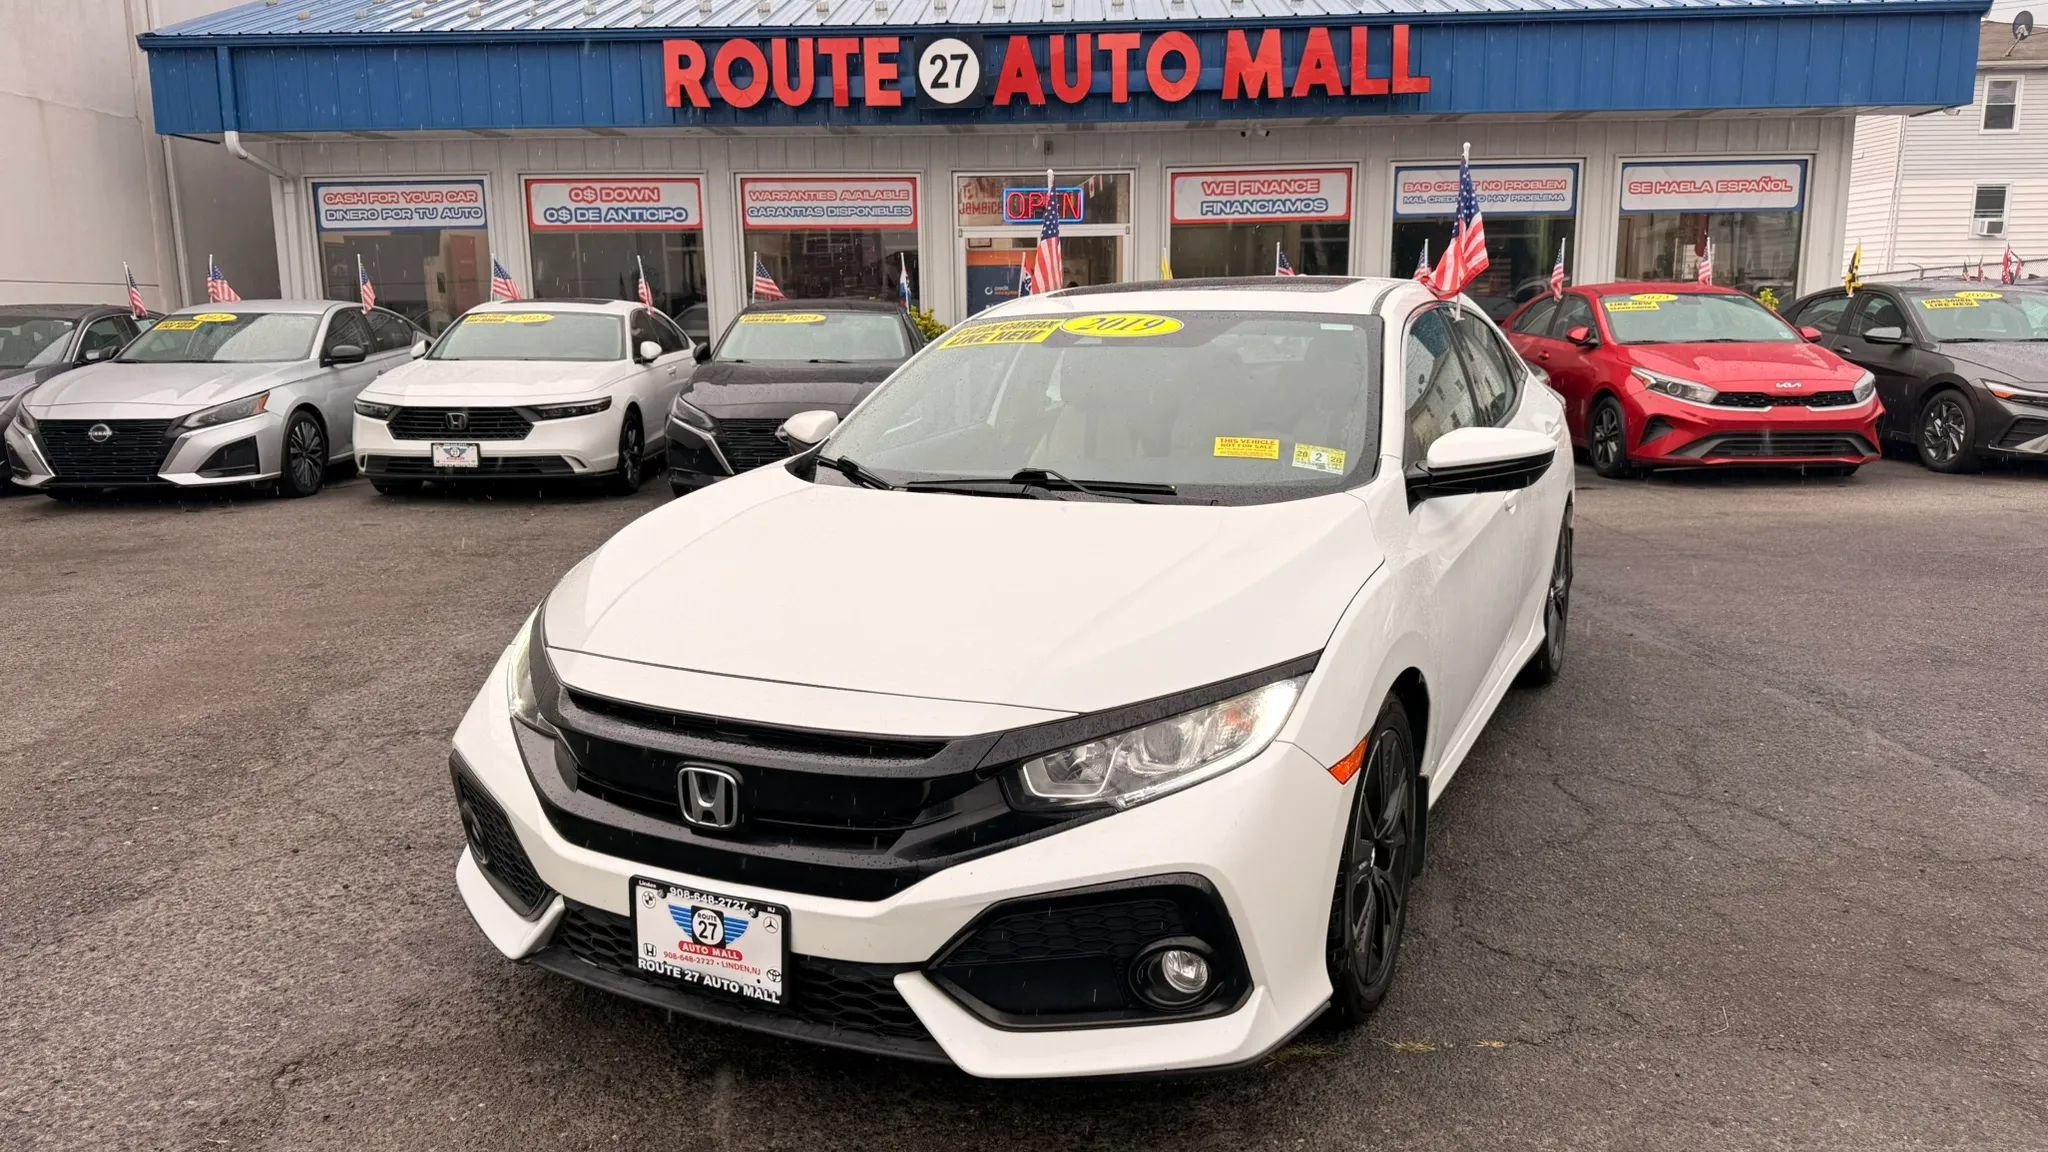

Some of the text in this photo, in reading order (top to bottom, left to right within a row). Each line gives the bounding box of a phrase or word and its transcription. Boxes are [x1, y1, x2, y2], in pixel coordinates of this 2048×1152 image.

[663, 24, 1431, 109] ROUTE 27 AUTO MALL
[1201, 179, 1320, 196] WE FINANCE
[1403, 179, 1567, 193] BAD CRET NO PROBLEM
[1629, 176, 1793, 194] SE HABLA ESPAÑOL
[324, 190, 478, 205] CASH FOR YOUR CAR
[600, 186, 660, 203] DOWN
[749, 189, 910, 202] WARRANTIES AVAILABLE
[1403, 195, 1426, 205] MAL
[325, 207, 483, 222] DINERO POR TU AUTO
[575, 207, 602, 223] DE
[604, 206, 688, 223] ANTICIPO
[748, 205, 912, 218] GARANTIAS DISPONIBLES
[1201, 198, 1327, 216] FINANCIAMOS
[1076, 317, 1166, 332] 2019
[989, 330, 1046, 343] NEW
[670, 887, 748, 910] 908-648-2727
[697, 912, 718, 923] ROUTE
[698, 920, 718, 940] 27
[682, 942, 740, 960] AUTO MALL
[638, 958, 781, 1004] ROUTE 27 AUTO MALL
